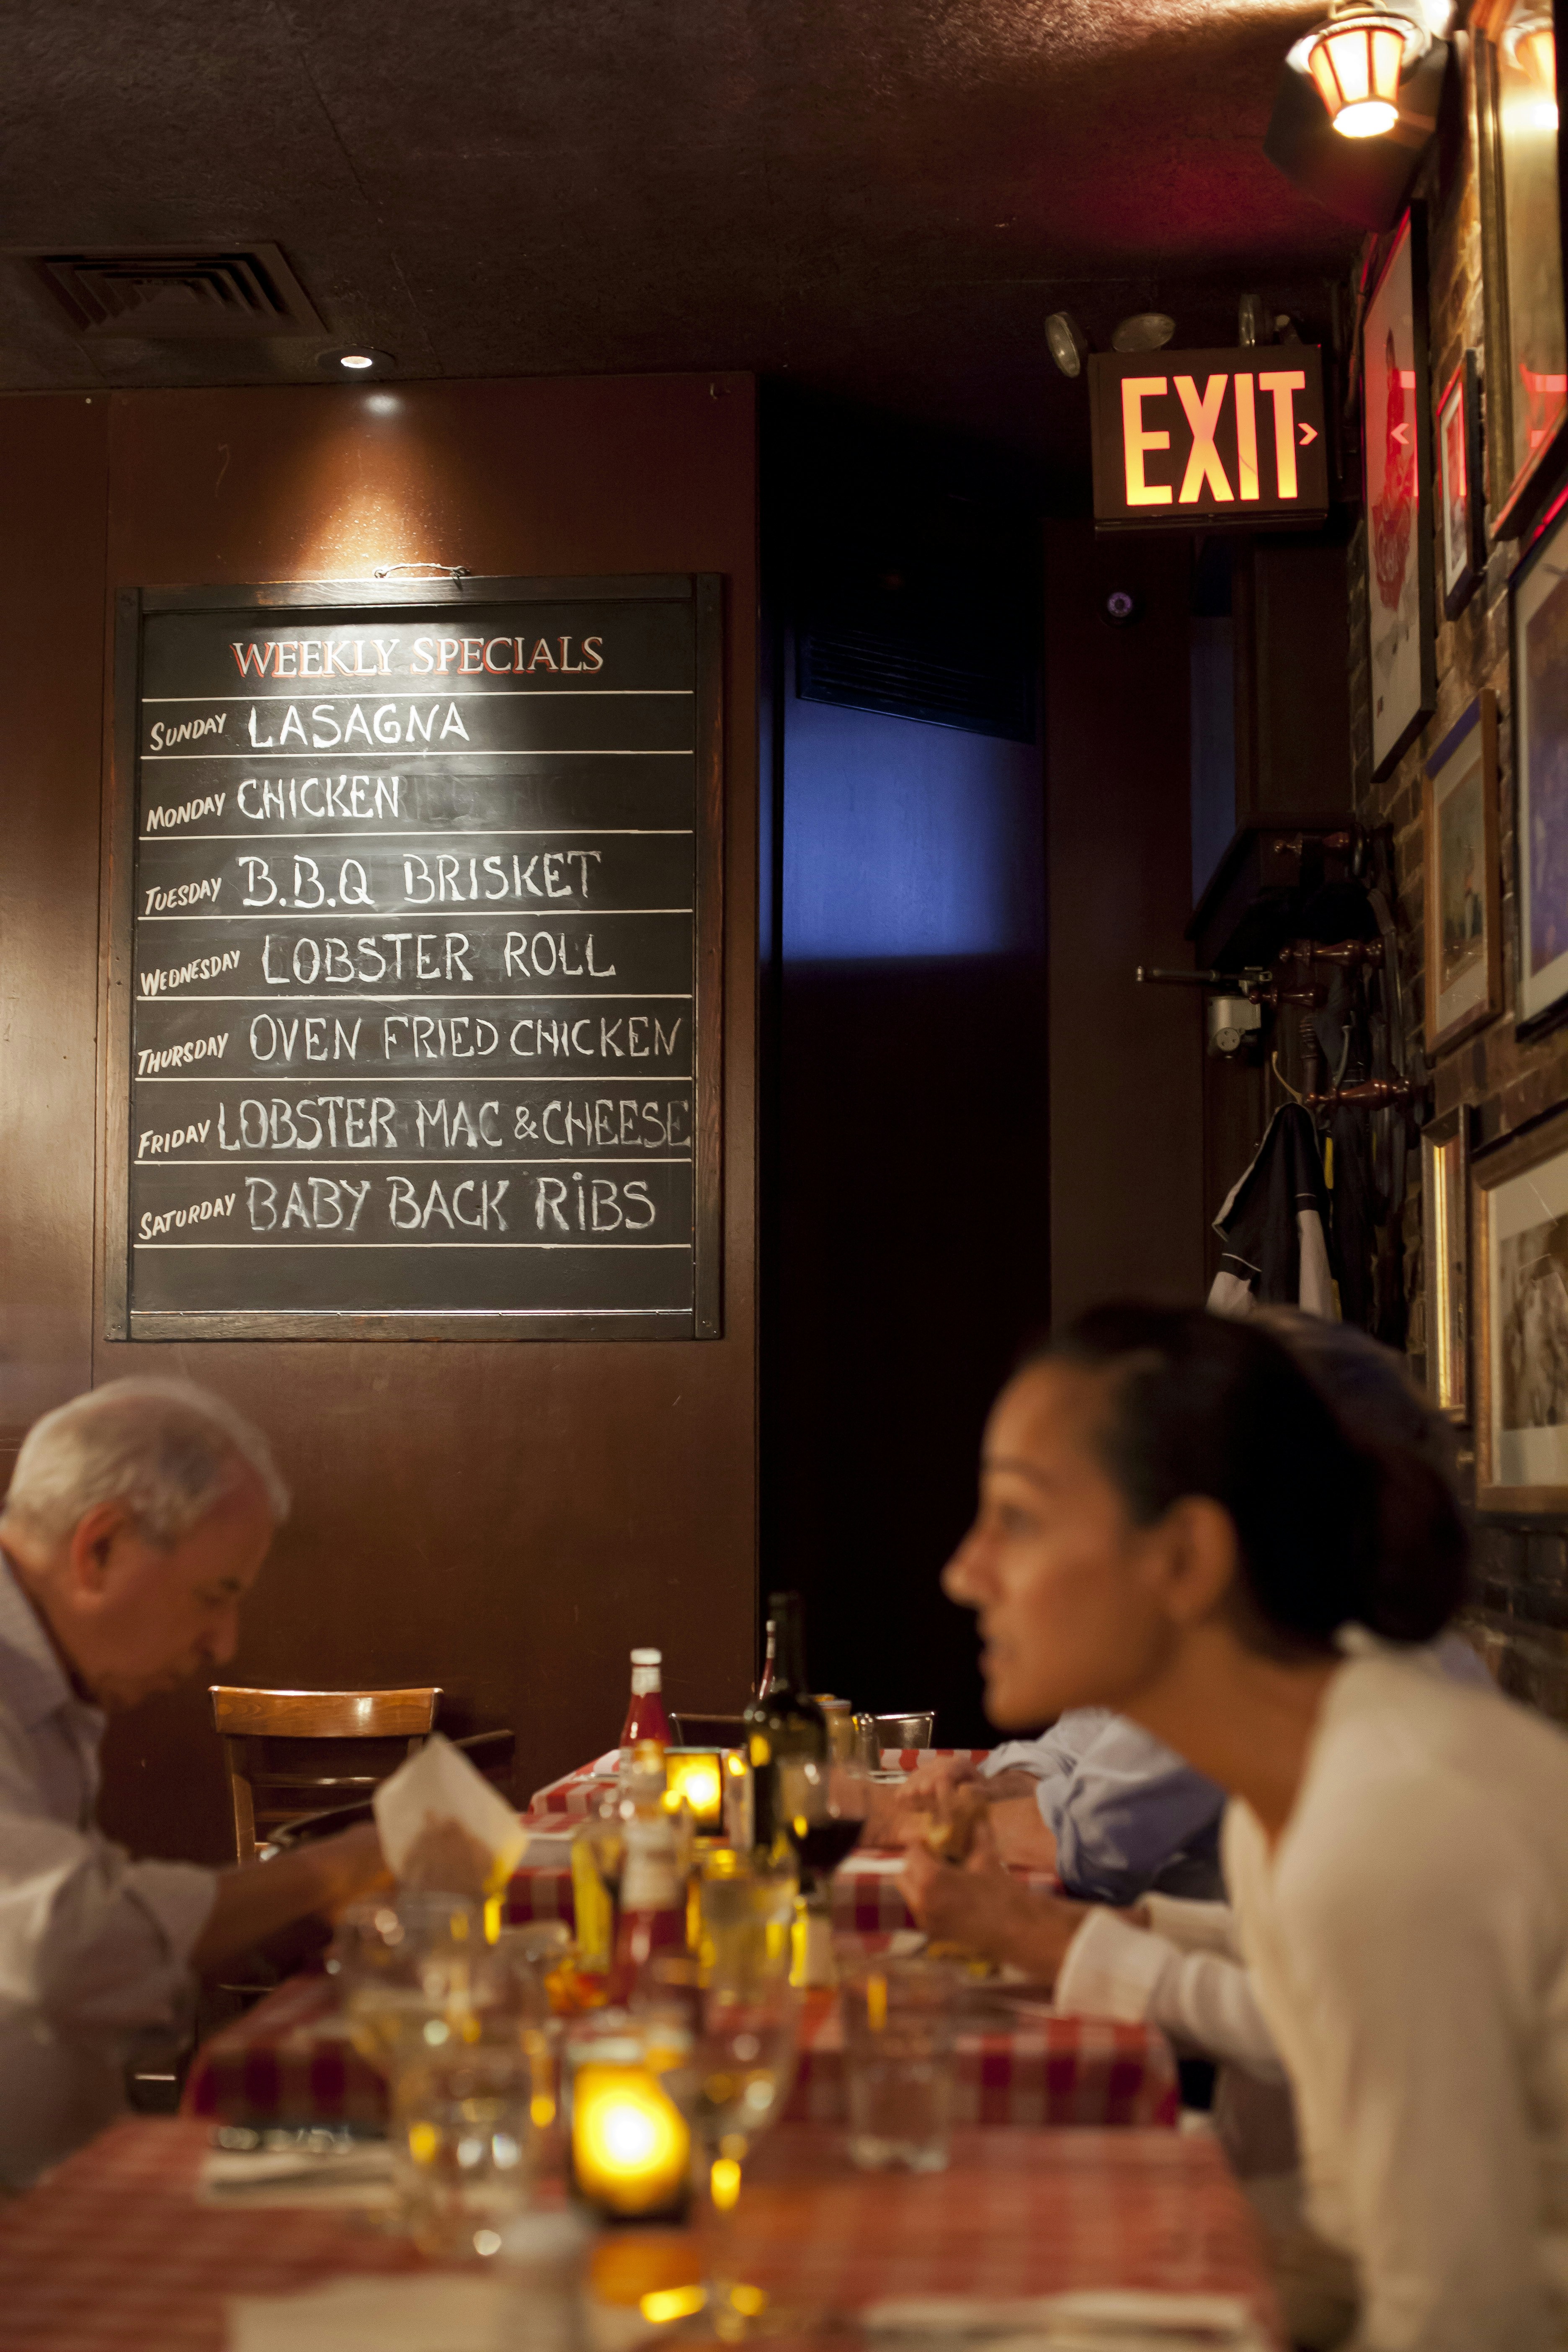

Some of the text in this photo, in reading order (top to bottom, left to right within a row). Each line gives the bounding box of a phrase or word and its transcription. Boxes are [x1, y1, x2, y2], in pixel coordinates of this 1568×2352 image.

[1122, 371, 1305, 506] EXIT
[230, 635, 604, 678] WEEKLY SPECIALS
[150, 702, 470, 751] SUNDAY LASAGNA
[146, 792, 226, 832] MONDAY
[237, 774, 400, 820] CHICKEN
[145, 850, 602, 916] TUESDAY B.B.Q BRISKET
[140, 931, 616, 996] WEDNESDAY LOBSTER ROLL
[137, 1014, 683, 1076] THURSDAY OVEN FRIED CHICKEN
[137, 1119, 211, 1159] FRIDAY
[218, 1097, 397, 1151] LOBSTER
[415, 1099, 503, 1148] MAC
[139, 1193, 236, 1240] SATURDAY
[245, 1176, 372, 1231] BABY
[386, 1175, 510, 1231] BACK
